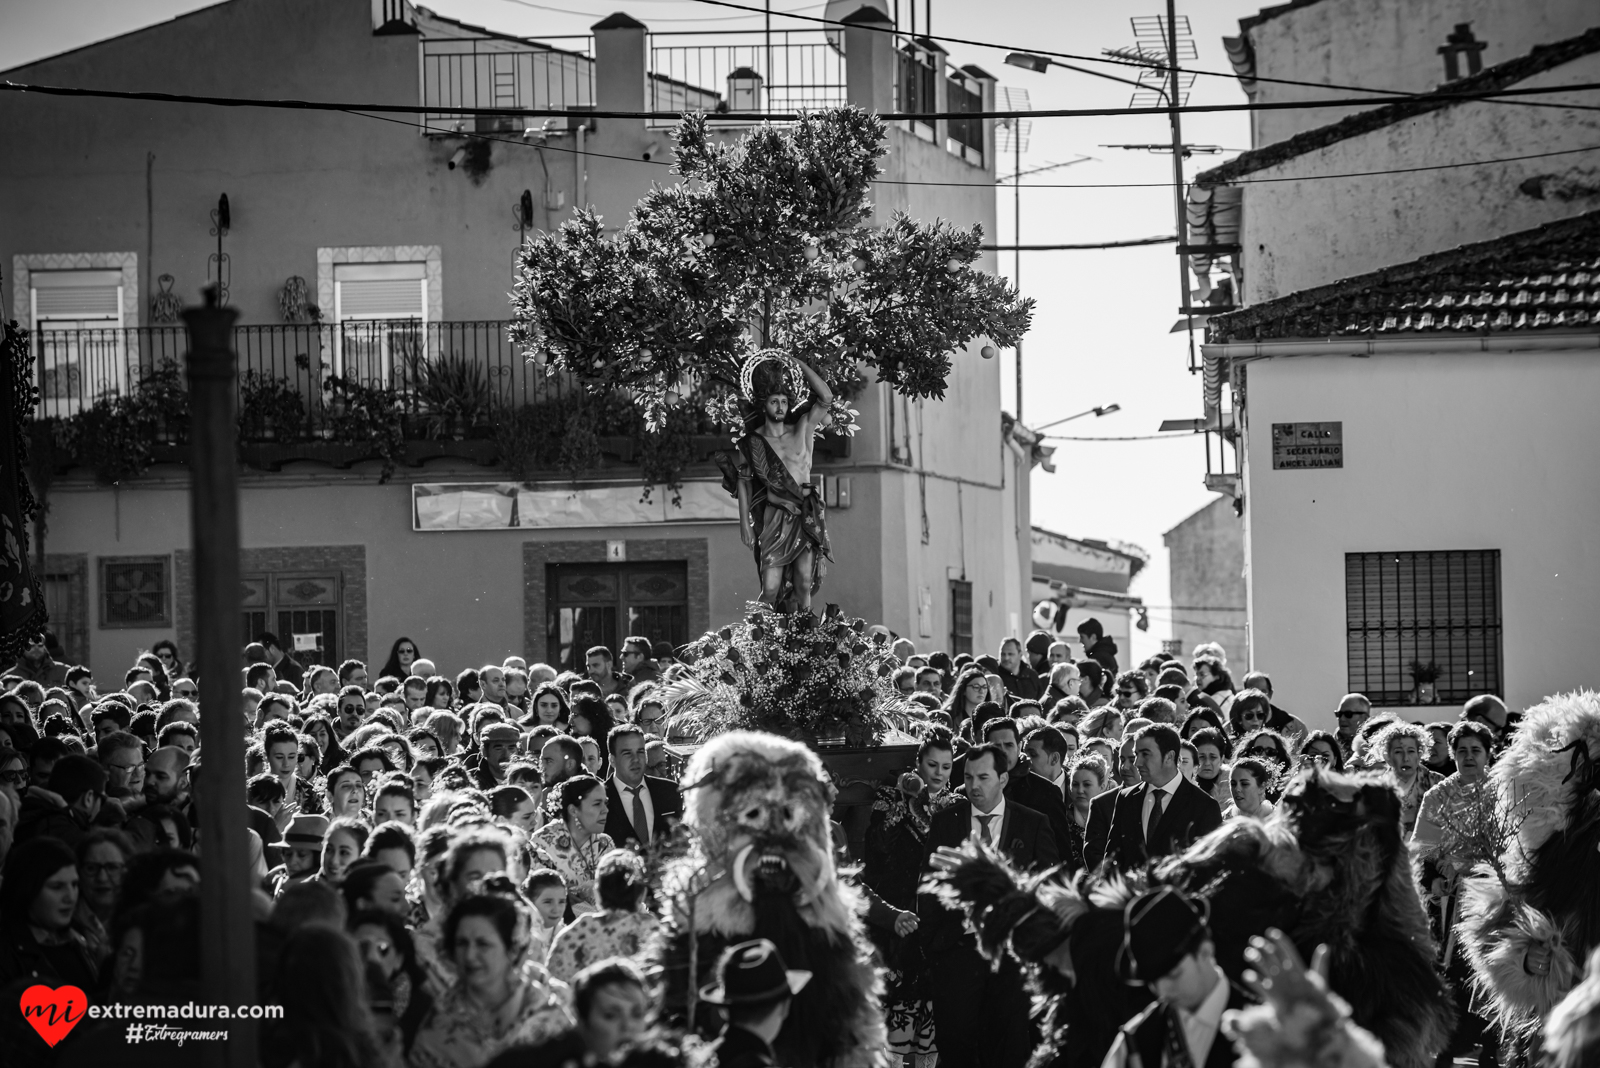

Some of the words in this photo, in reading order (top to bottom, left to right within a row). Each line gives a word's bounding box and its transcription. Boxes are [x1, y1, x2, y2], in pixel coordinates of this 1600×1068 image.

[1301, 430, 1331, 439] CALLE
[1286, 447, 1340, 456] SECRETARIO
[1309, 459, 1340, 467] JULIAN
[612, 546, 619, 557] 4
